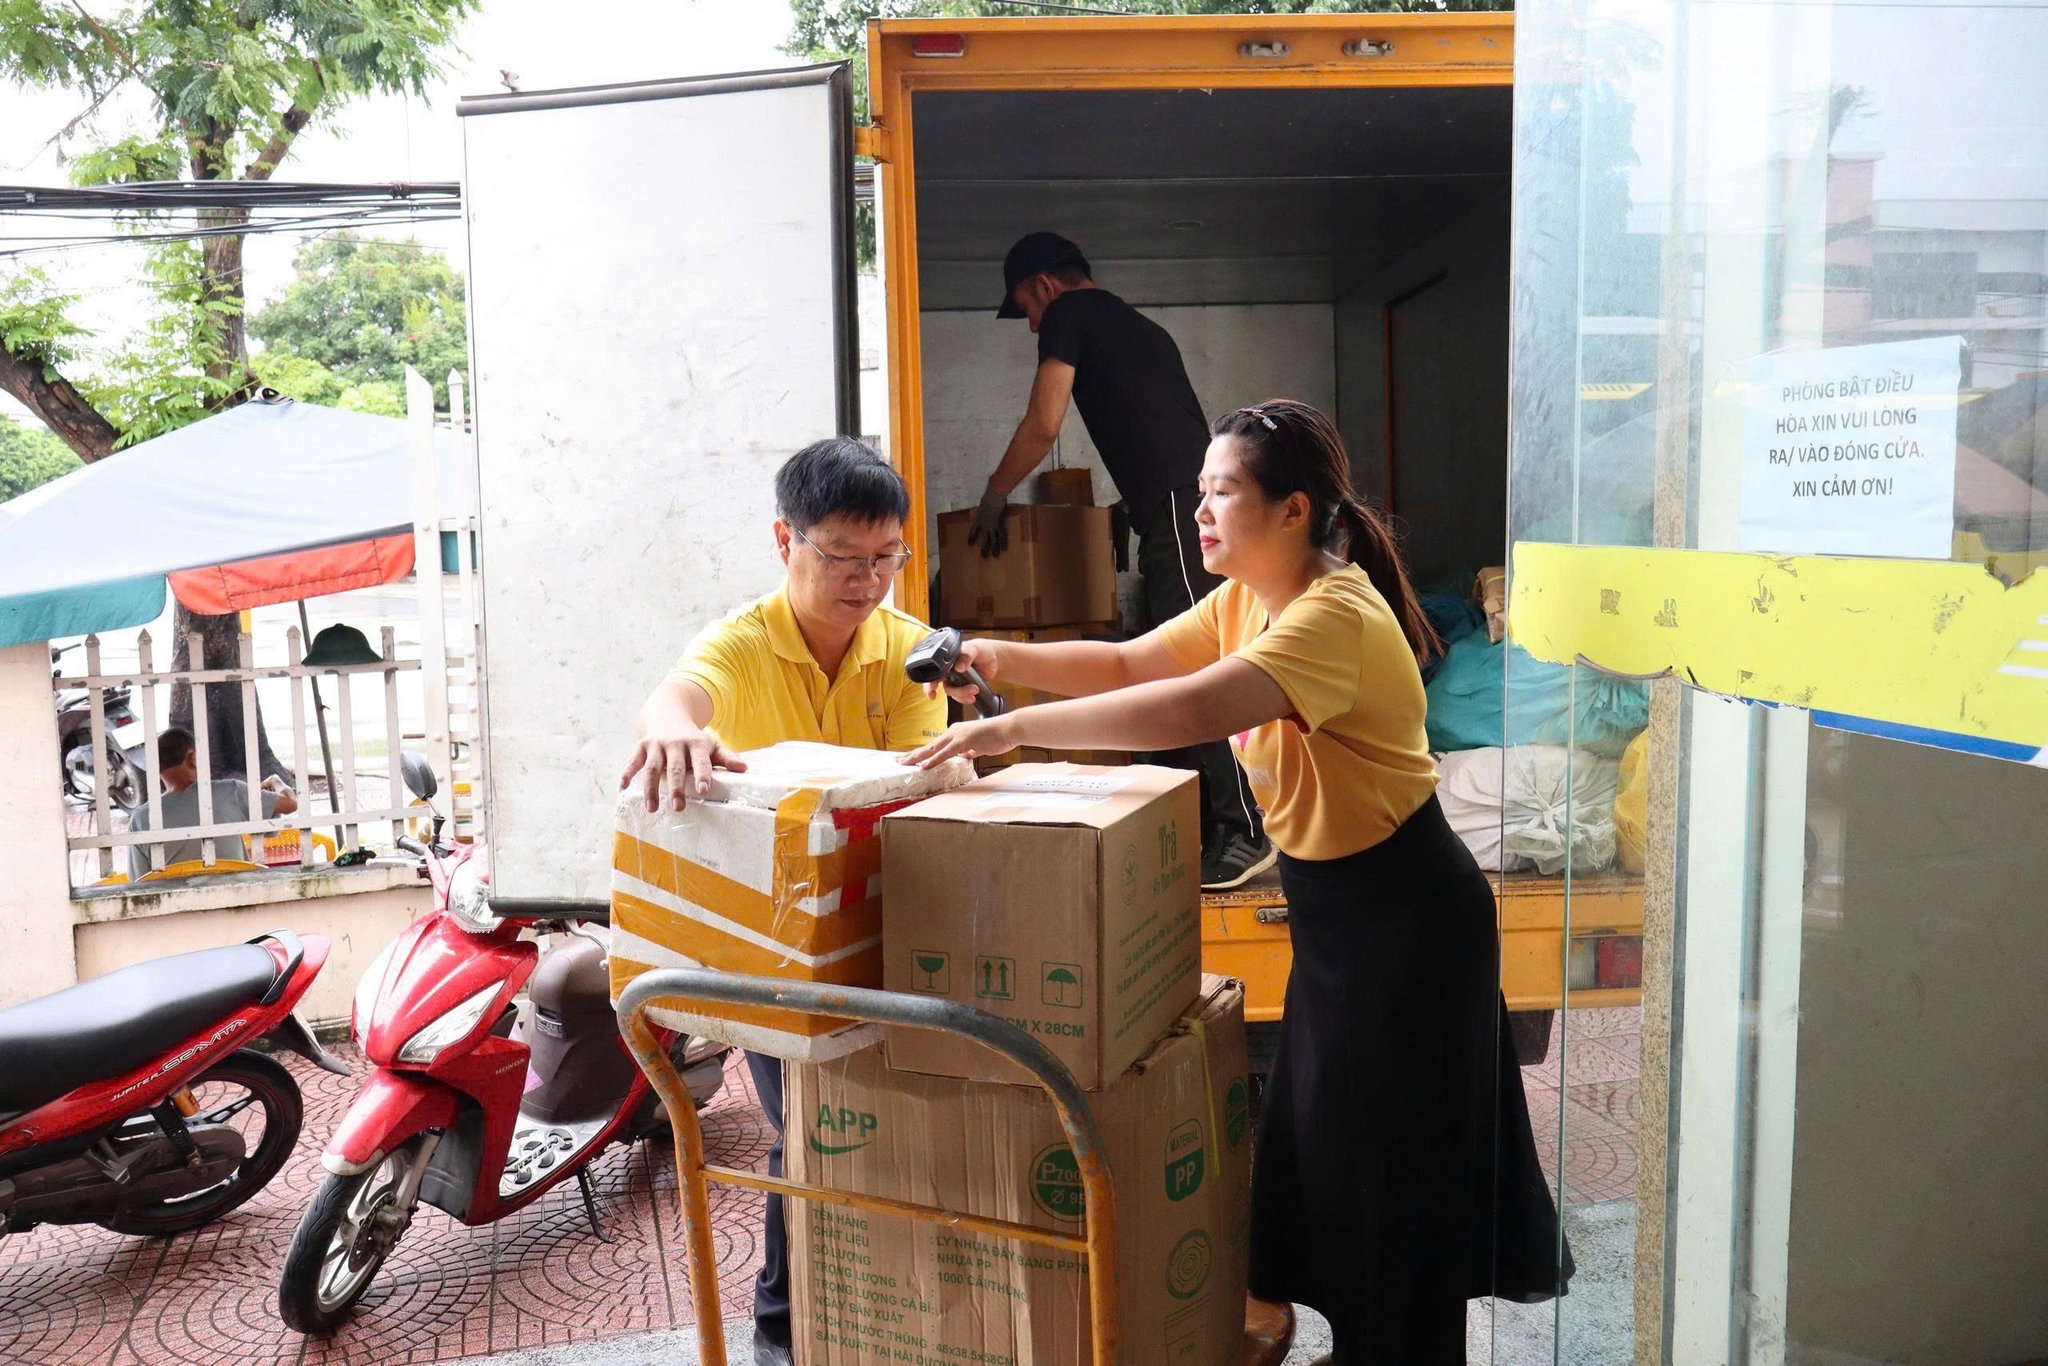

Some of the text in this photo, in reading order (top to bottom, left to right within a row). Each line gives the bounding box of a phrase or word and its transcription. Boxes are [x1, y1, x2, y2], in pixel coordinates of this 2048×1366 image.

[1782, 369, 1914, 402] PHÒNG BẬT ĐIỀU
[1776, 405, 1917, 434] HÒA XIN VUI LÒNG
[1769, 435, 1925, 467] RA/ VÀO ĐÓNG CỬA.
[1792, 473, 1894, 497] XIN CẢM ƠN!
[1032, 1020, 1041, 1033] X
[1044, 1022, 1085, 1038] 28CM
[111, 1019, 247, 1101] JUPITER GRAVITA
[495, 1058, 525, 1075] HONDA
[816, 1103, 878, 1138] APP
[1169, 1127, 1199, 1152] MATERIAL
[1175, 1160, 1196, 1192] PP
[837, 1214, 869, 1231] HÀNG
[937, 1236, 951, 1248] LY
[832, 1248, 872, 1266] LƯỢNG
[937, 1271, 964, 1284] 1000
[845, 1231, 870, 1248] LIỆU
[937, 1252, 973, 1268] NHỰA
[976, 1259, 992, 1271] PP
[813, 1260, 897, 1289] TRỌNG LƯỢNG
[814, 1277, 853, 1295] TRỌNG
[856, 1290, 898, 1306] LƯỢNG
[845, 1319, 884, 1339] THƯỚC
[887, 1329, 928, 1350] THÙNG
[872, 1344, 890, 1360] TẠI
